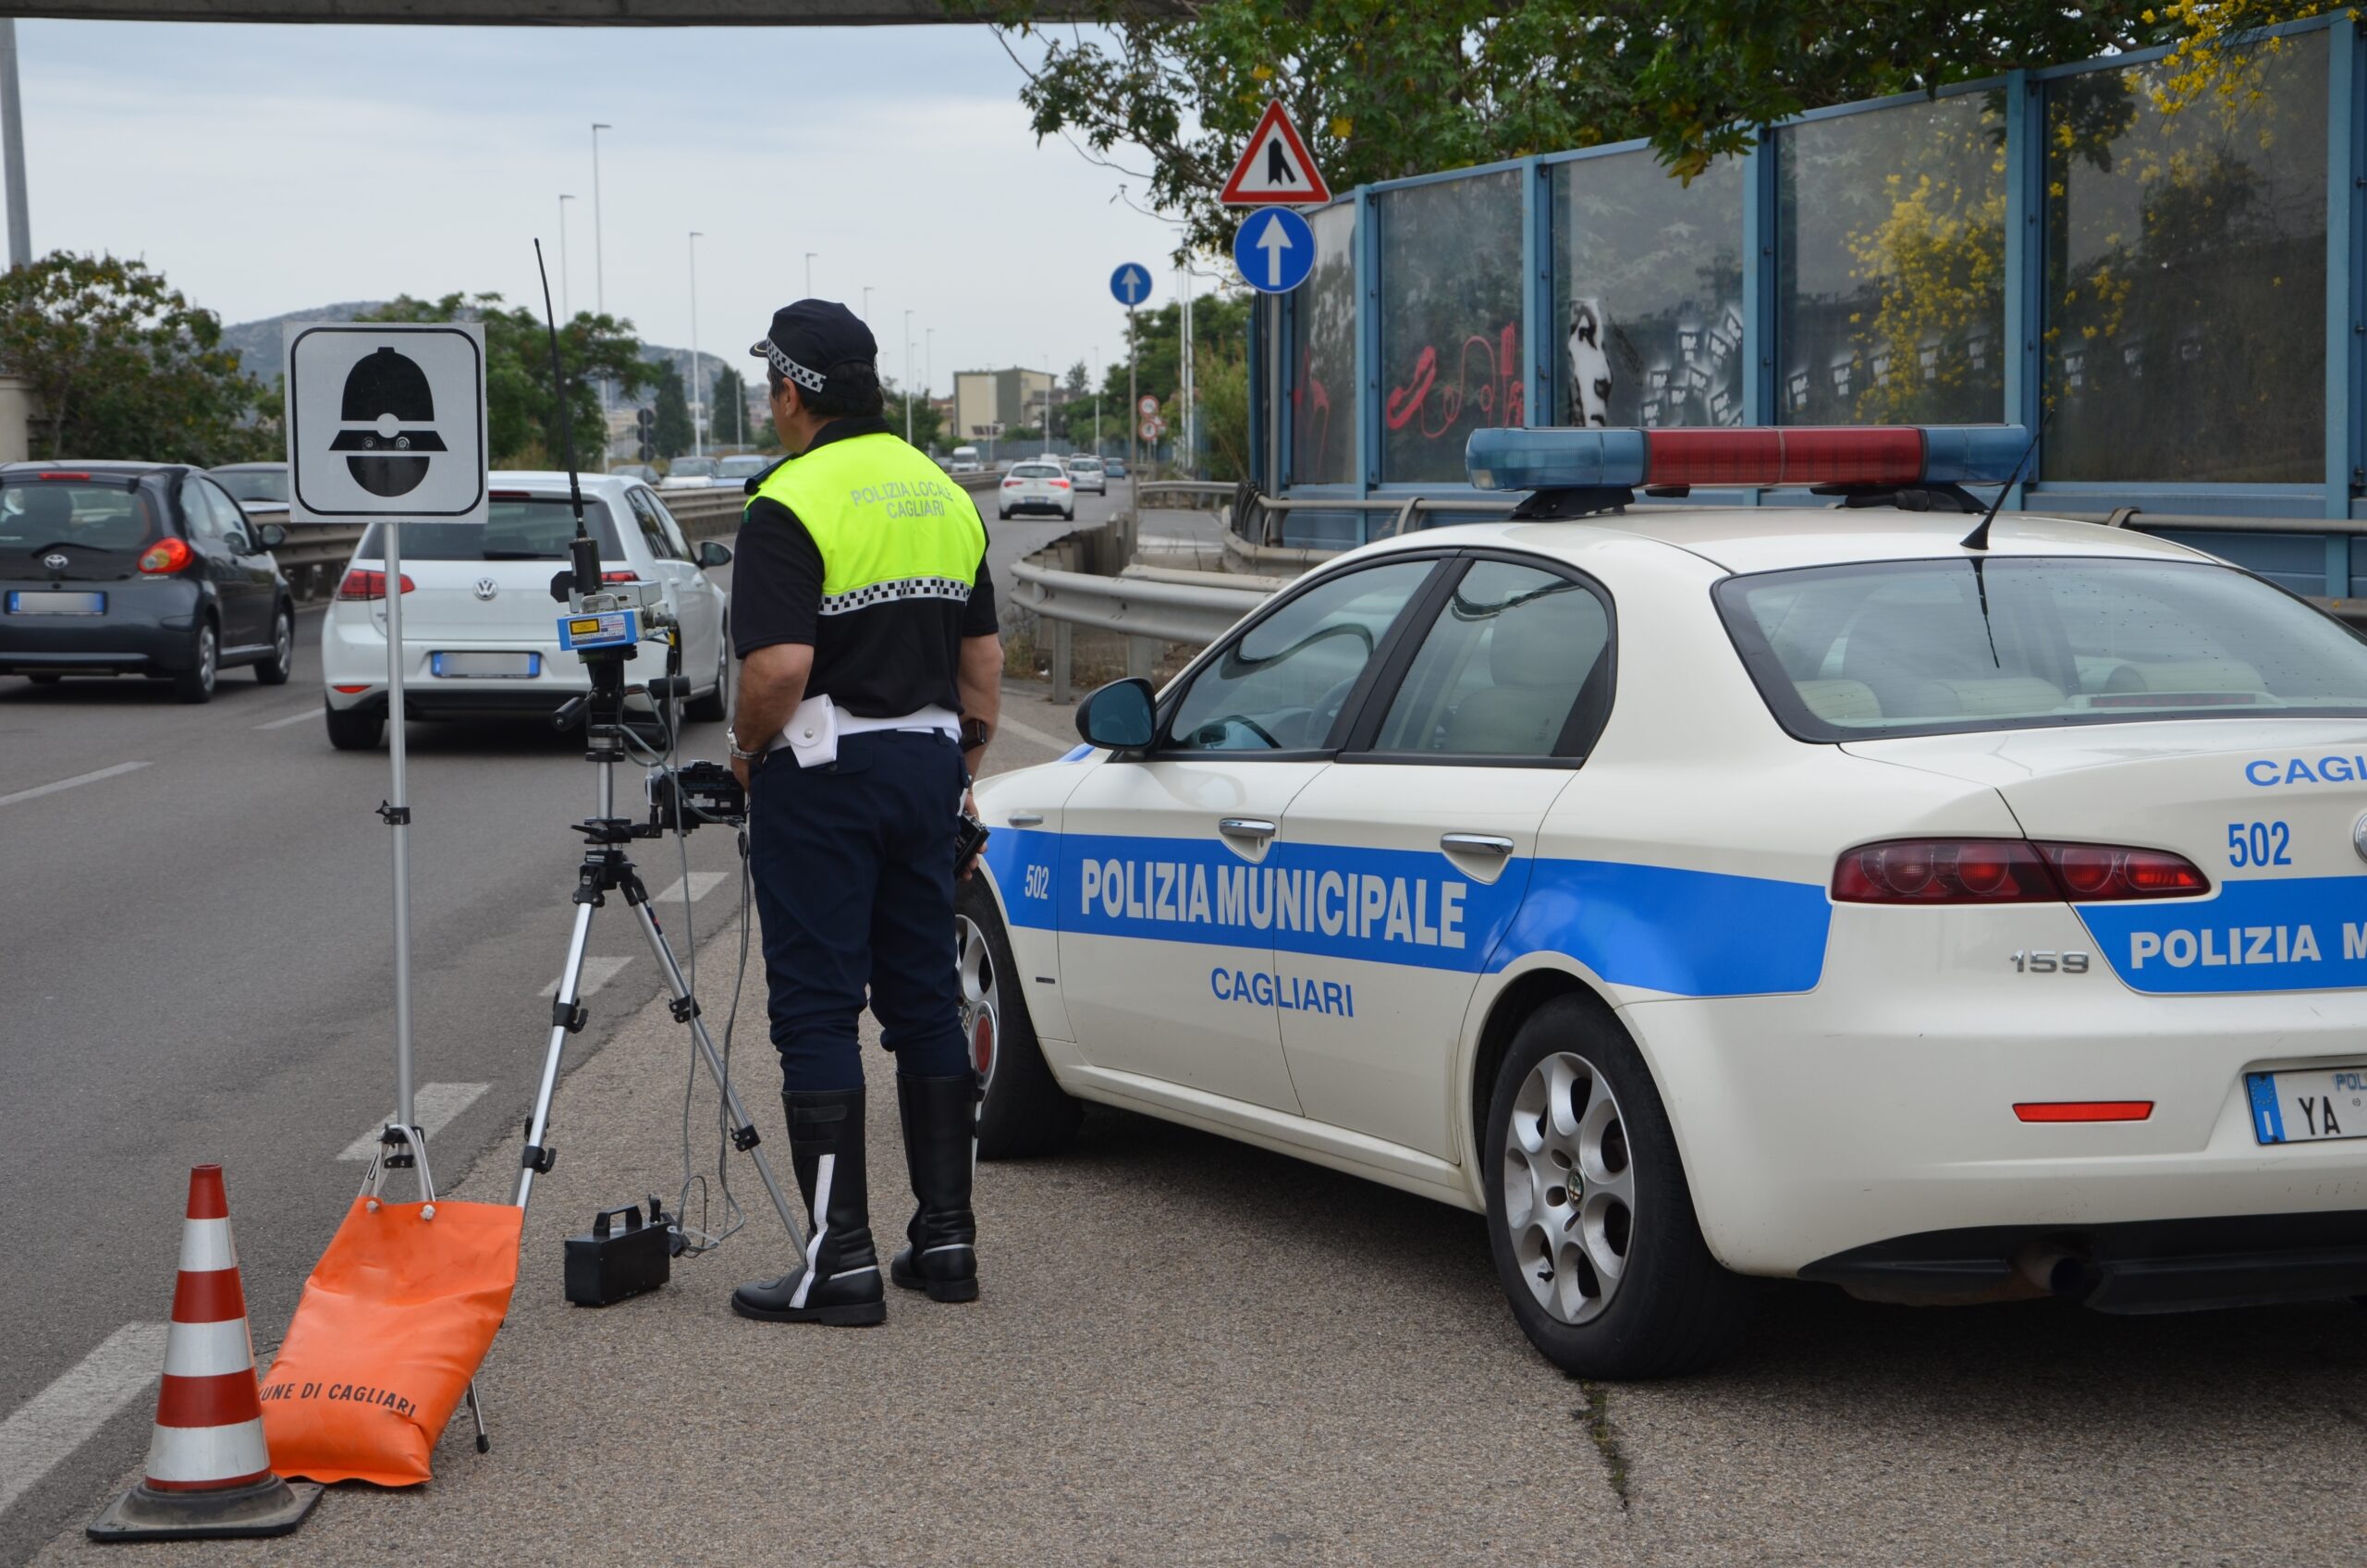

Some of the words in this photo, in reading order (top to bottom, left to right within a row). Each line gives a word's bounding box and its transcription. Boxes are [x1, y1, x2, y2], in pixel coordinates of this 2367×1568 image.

[851, 482, 911, 508] POLIZIA
[910, 481, 954, 502] LOCALE
[887, 500, 945, 519] CAGLIARI
[2227, 821, 2292, 867] 502
[1024, 864, 1049, 900] 502
[1082, 858, 1212, 924] POLIZIA
[1217, 864, 1467, 949] MUNICIPALE
[2010, 949, 2090, 974] 159
[2130, 925, 2322, 969] POLIZIA
[1211, 967, 1355, 1017] CAGLIARI
[2298, 1095, 2341, 1136] YA
[300, 1382, 323, 1400] DI
[328, 1383, 416, 1418] CAGLIARI
